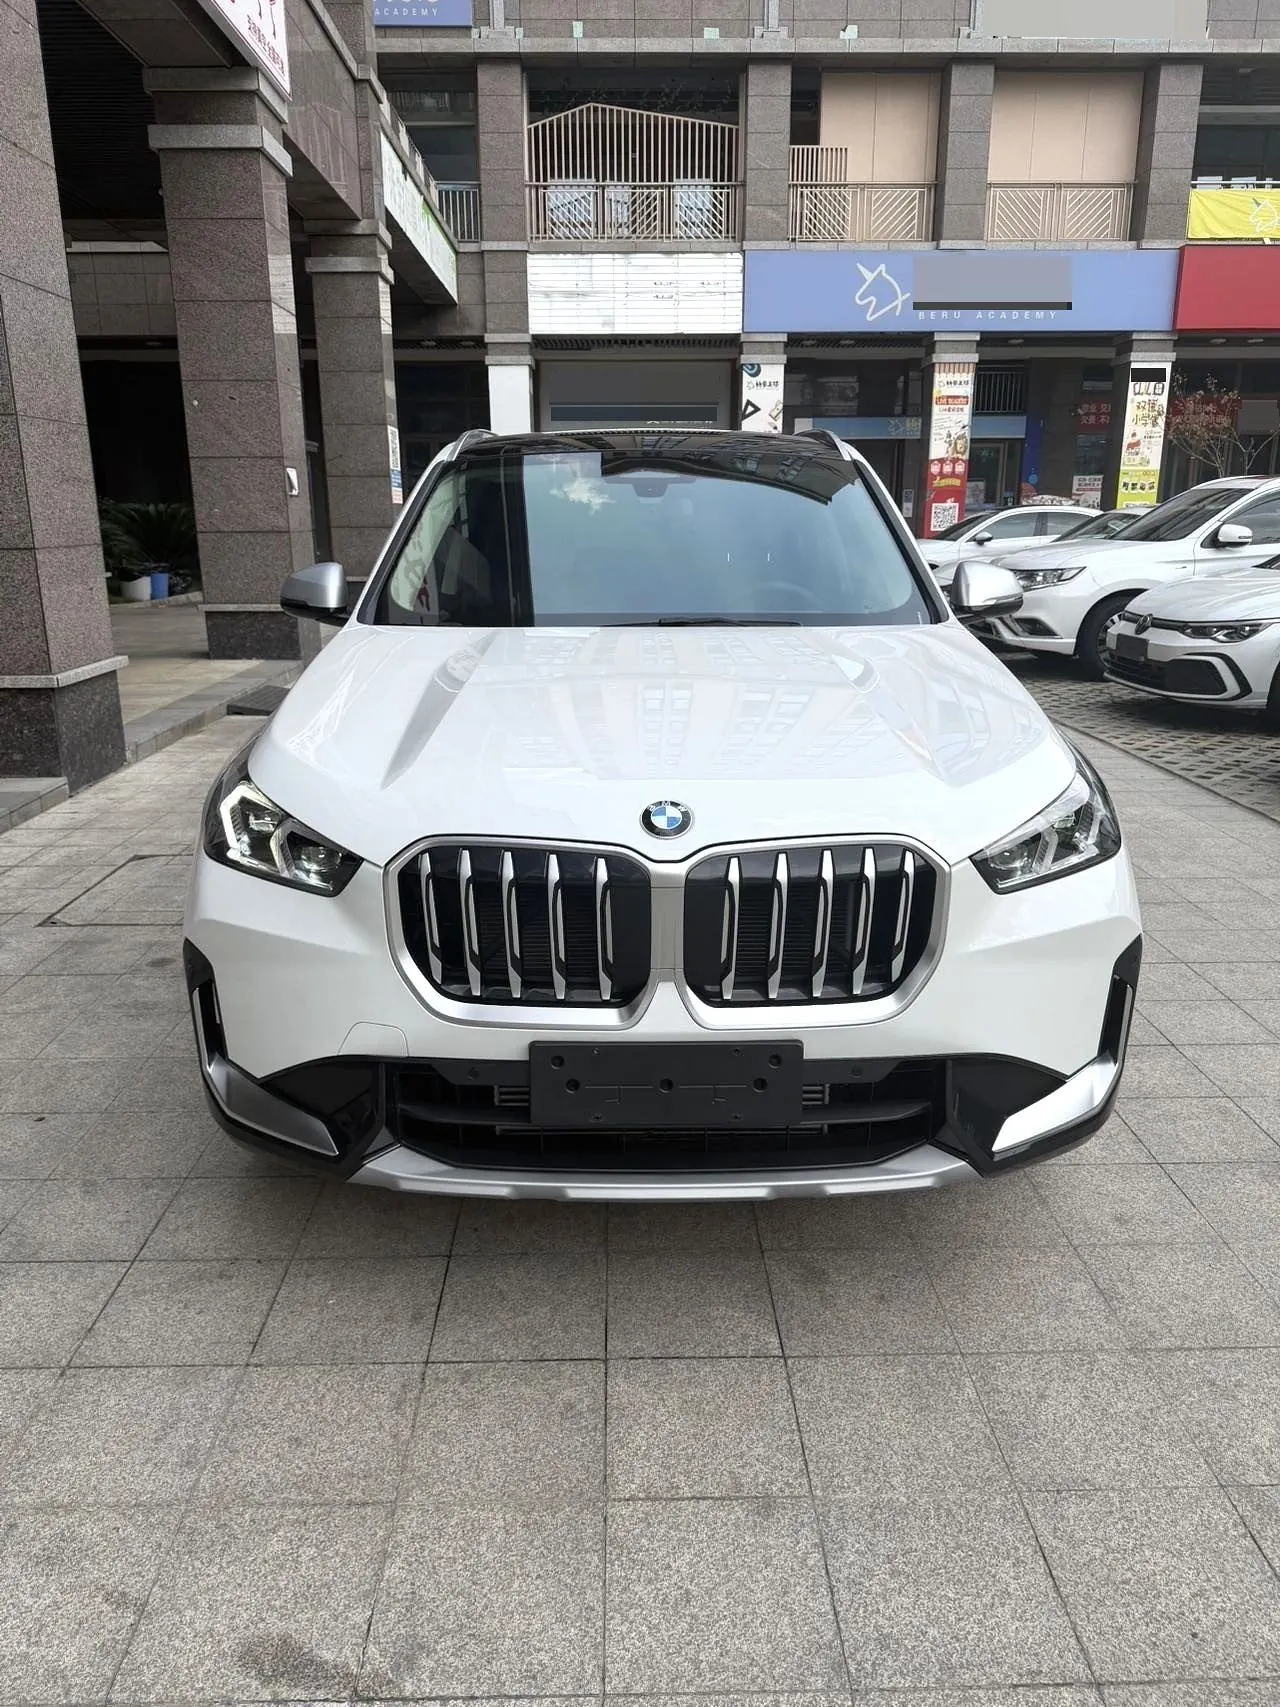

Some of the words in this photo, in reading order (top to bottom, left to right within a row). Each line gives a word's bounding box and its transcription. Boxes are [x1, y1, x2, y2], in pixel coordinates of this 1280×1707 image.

[374, 7, 438, 16] ACADEMY
[918, 311, 961, 320] BERU
[976, 311, 1057, 320] ACADEMY
